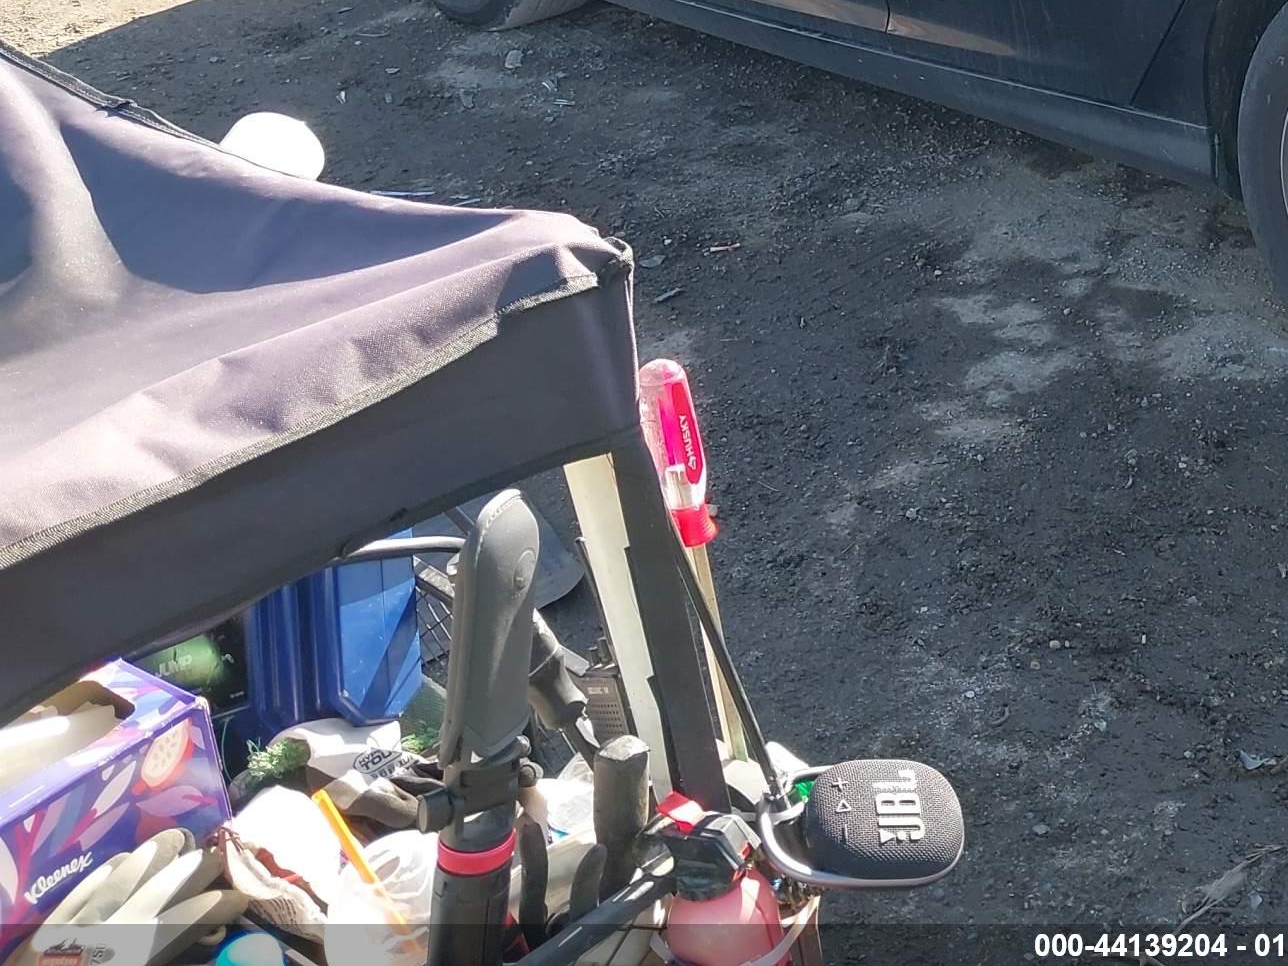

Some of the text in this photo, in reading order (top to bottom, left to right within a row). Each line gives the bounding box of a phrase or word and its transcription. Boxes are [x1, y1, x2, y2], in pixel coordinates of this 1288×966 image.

[678, 414, 697, 459] HUSKY
[871, 769, 926, 843] JBL
[23, 850, 94, 905] Kleenex
